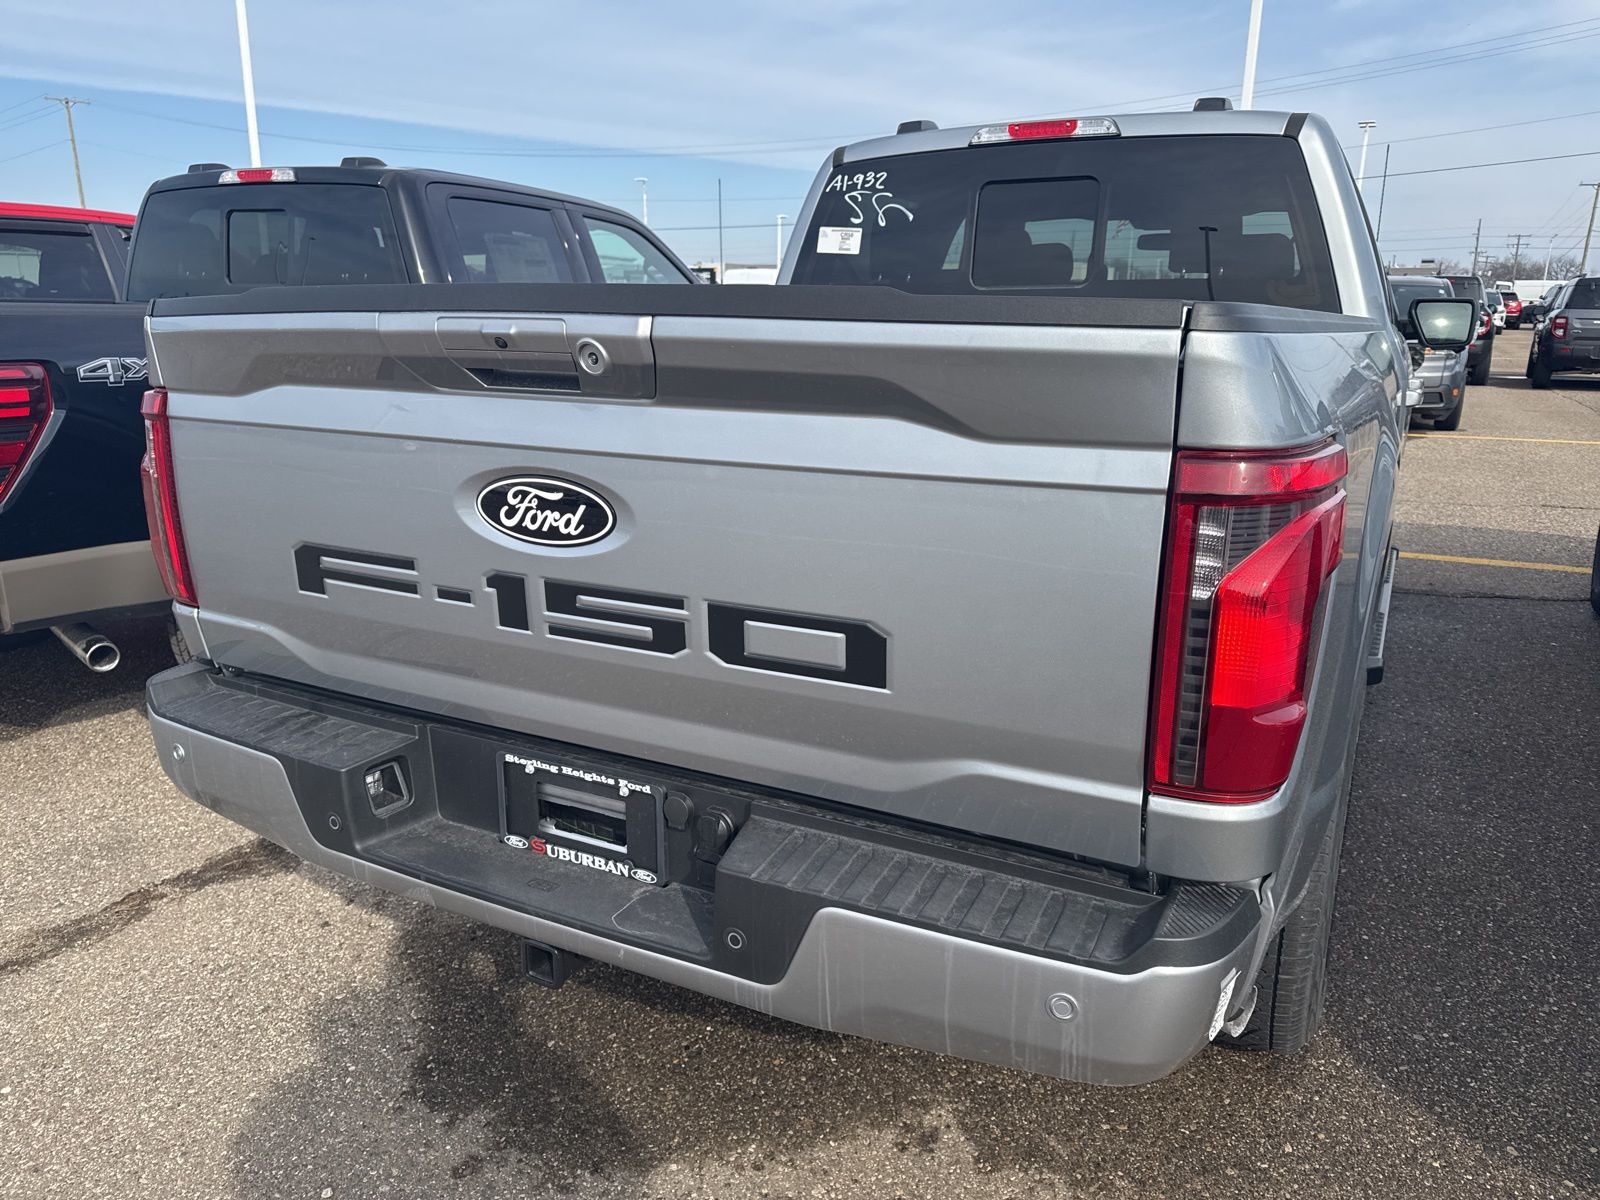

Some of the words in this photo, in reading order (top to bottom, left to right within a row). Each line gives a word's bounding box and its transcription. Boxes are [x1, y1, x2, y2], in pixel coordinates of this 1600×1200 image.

[499, 484, 585, 538] Ford
[292, 540, 892, 694] F-150
[504, 753, 559, 774] Sterling
[561, 766, 615, 785] Heights
[618, 778, 652, 794] Ford
[530, 836, 629, 878] SUBURBAN
